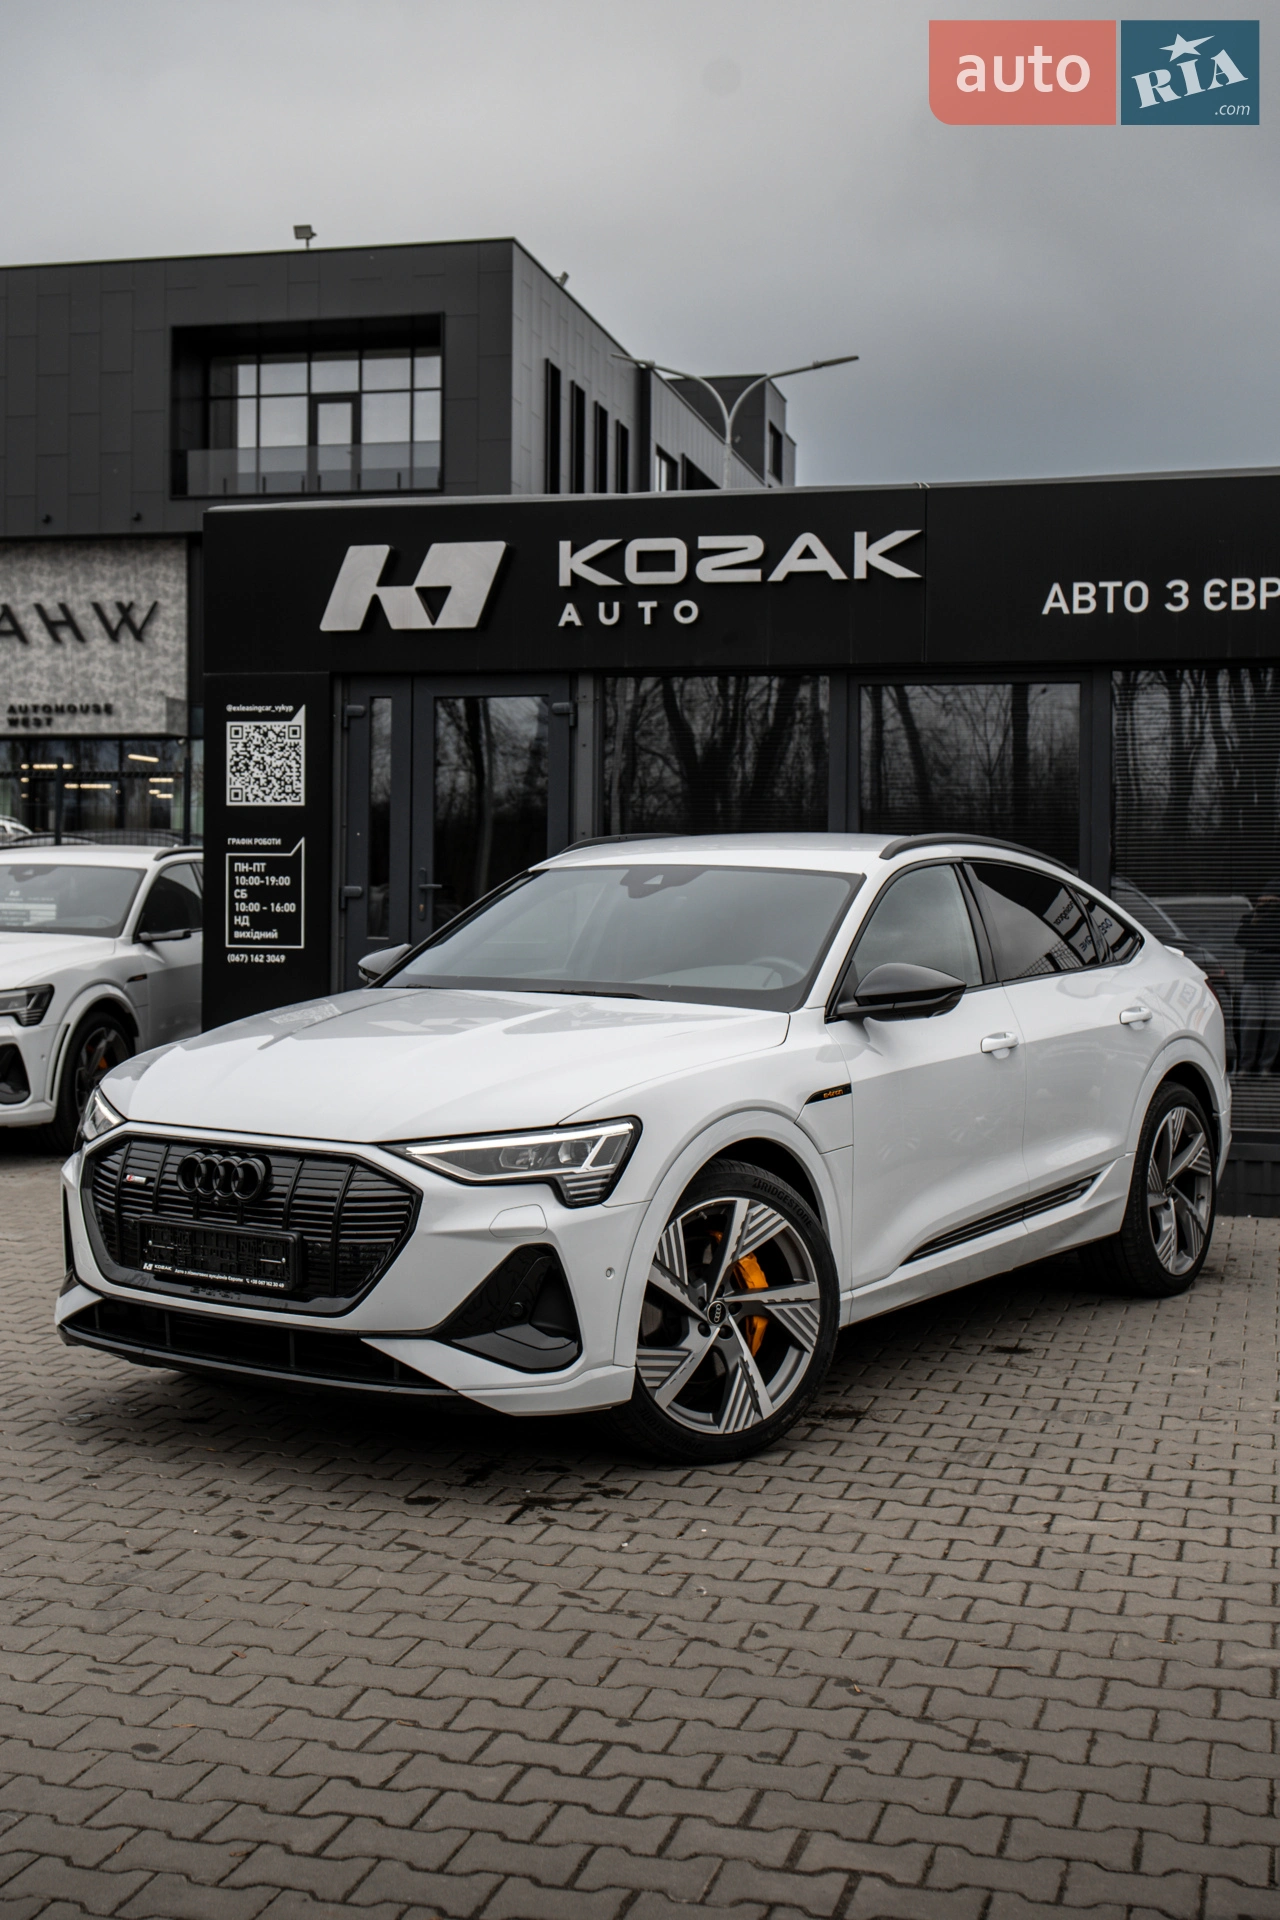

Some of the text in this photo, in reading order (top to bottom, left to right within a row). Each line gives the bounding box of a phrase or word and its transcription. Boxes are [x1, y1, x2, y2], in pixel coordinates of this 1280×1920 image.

[559, 530, 923, 587] KOZAK
[1041, 580, 1149, 615] АВТО
[1203, 576, 1280, 612] ЄВР
[558, 600, 699, 627] AUTO
[0, 601, 158, 645] AHW
[7, 703, 114, 716] AUTOHOUSE
[7, 716, 54, 728] WEST
[227, 838, 282, 846] ГРАФІК РОБОТИ
[234, 862, 266, 873] ПН-ПТ
[234, 875, 291, 886] 10:00-19:00
[233, 888, 248, 899] СБ
[234, 902, 260, 912] 10:00
[270, 903, 297, 913] 16:00
[233, 915, 250, 927] НД
[233, 929, 279, 940] вихідний
[226, 954, 286, 963] (067) 162 3049
[752, 1177, 812, 1229] BRIDGESTONE
